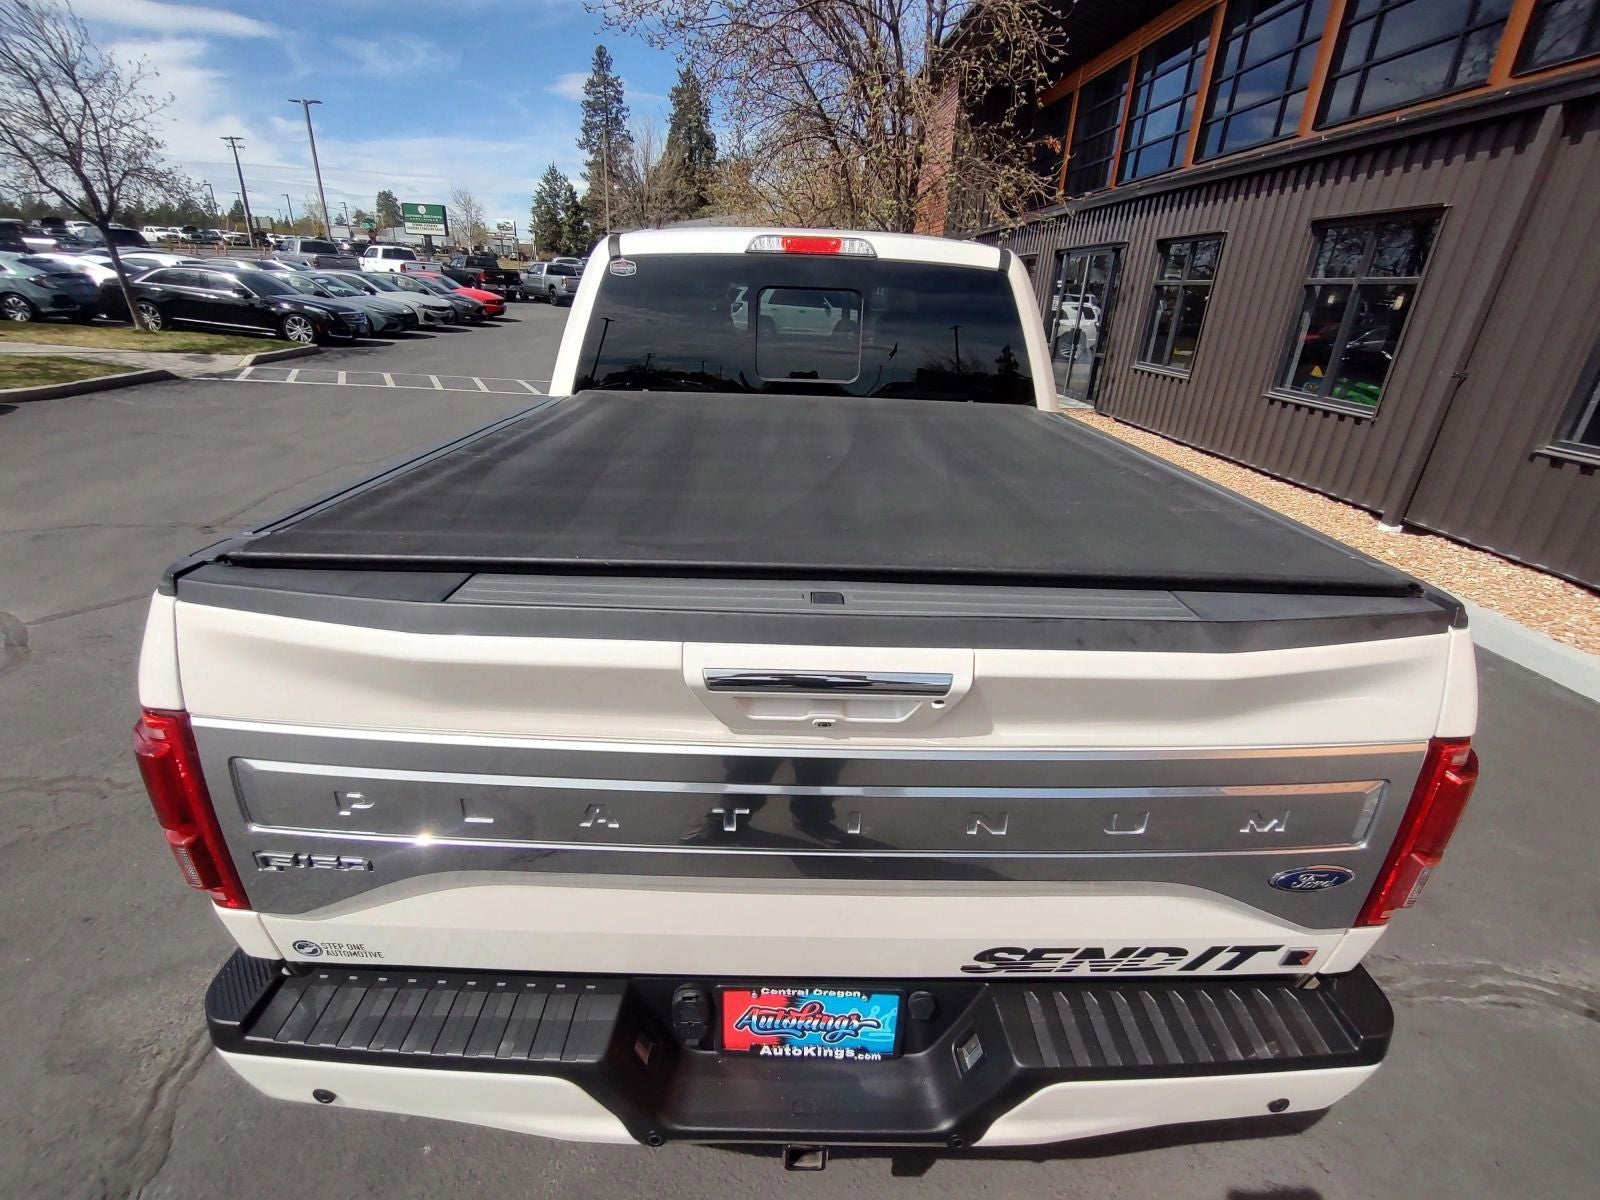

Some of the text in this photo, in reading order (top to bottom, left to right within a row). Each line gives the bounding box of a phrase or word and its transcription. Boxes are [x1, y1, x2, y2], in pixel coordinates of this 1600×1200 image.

[333, 790, 1292, 834] PLATINUM
[1290, 873, 1339, 889] Ford
[320, 942, 365, 951] STEP ONE
[326, 949, 384, 959] AUTOMOTIVE
[760, 987, 861, 998] Central Oregon
[759, 1045, 882, 1061] AutoKings.com
